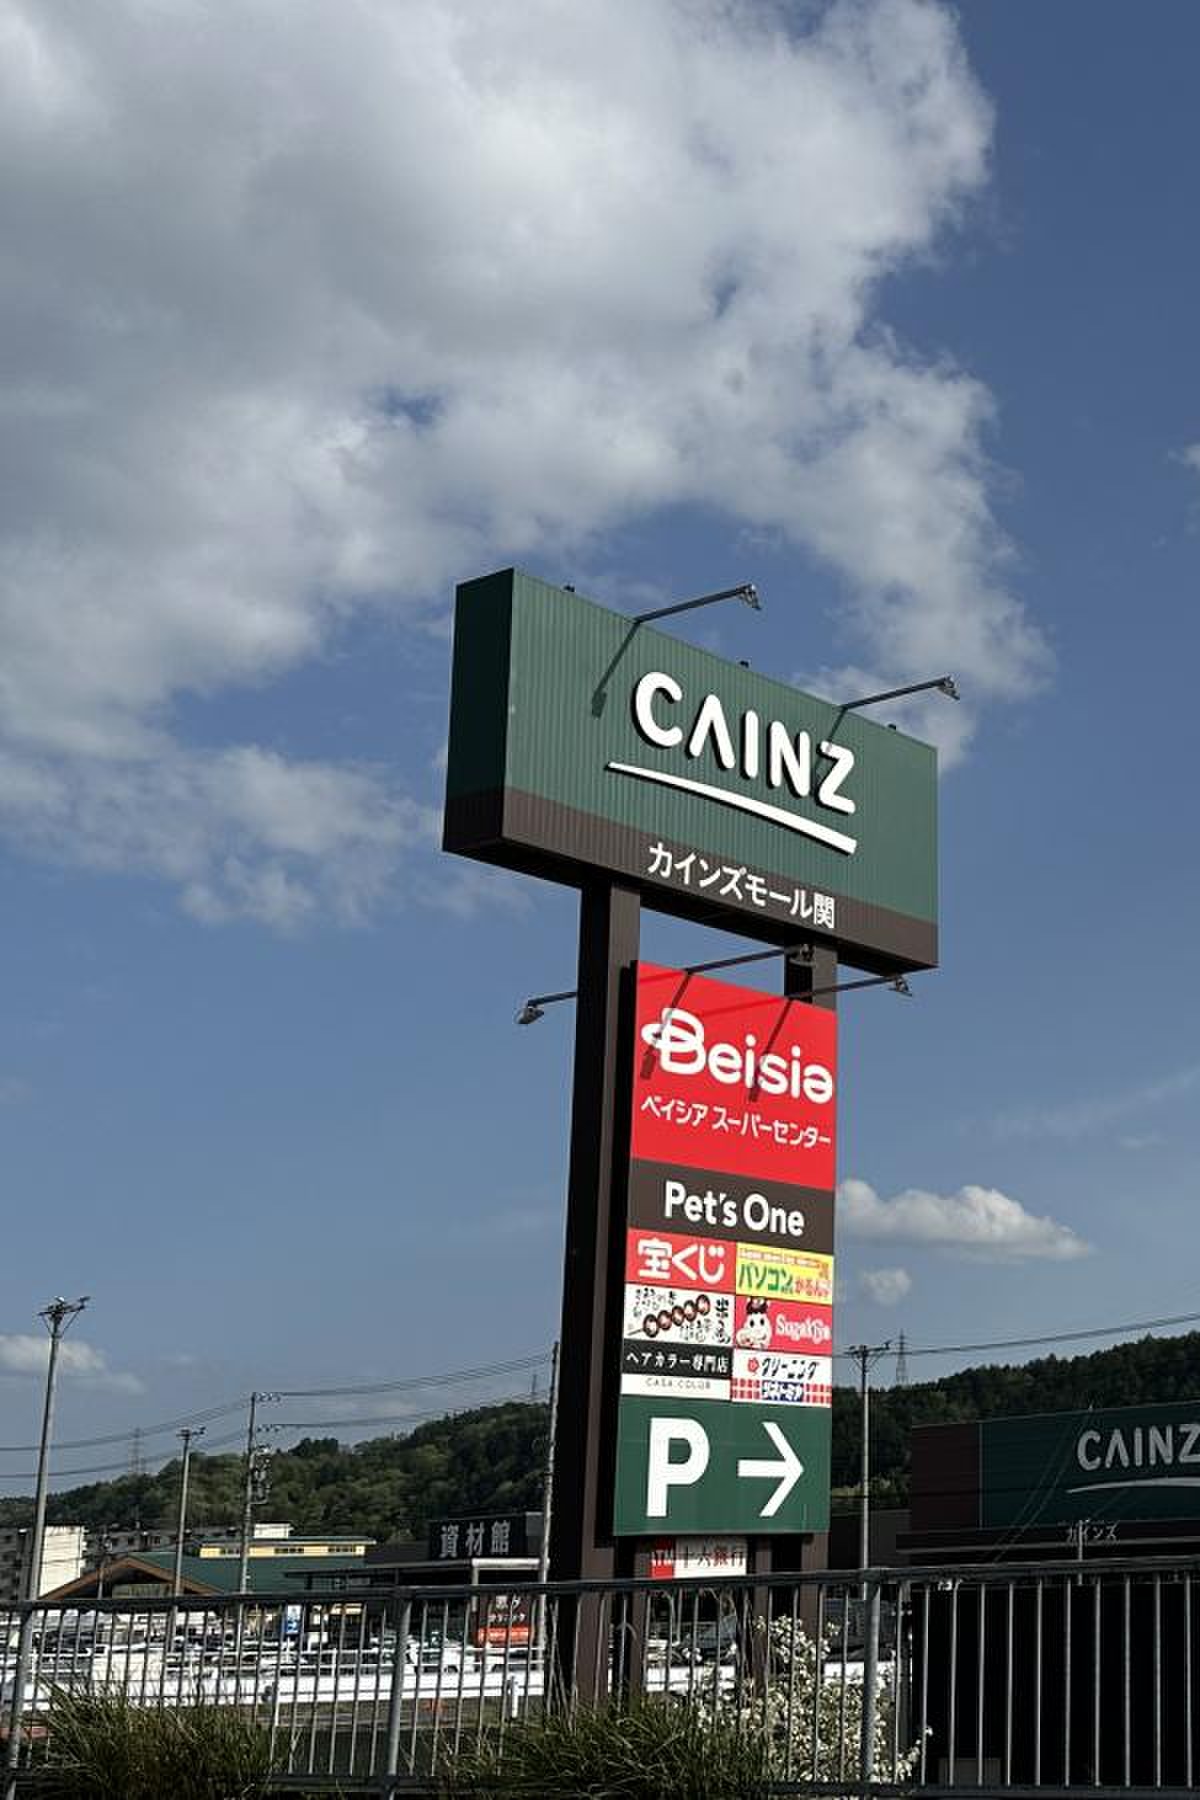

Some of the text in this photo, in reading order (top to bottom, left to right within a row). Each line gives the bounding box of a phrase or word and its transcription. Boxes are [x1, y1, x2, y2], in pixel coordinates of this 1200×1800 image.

[633, 671, 857, 816] CAINZ
[647, 841, 836, 929] カインズモール関
[641, 1007, 833, 1104] Beisia
[641, 1096, 831, 1148] ベイシア スーパーセンター
[664, 1180, 805, 1237] Pet's One
[637, 1237, 725, 1284] 宝くじ
[739, 1263, 793, 1291] パソコン
[626, 1352, 729, 1374] ヘアカラー専門店
[761, 1357, 820, 1380] クリーニング
[646, 1417, 710, 1517] P
[438, 1520, 511, 1558] 資材館
